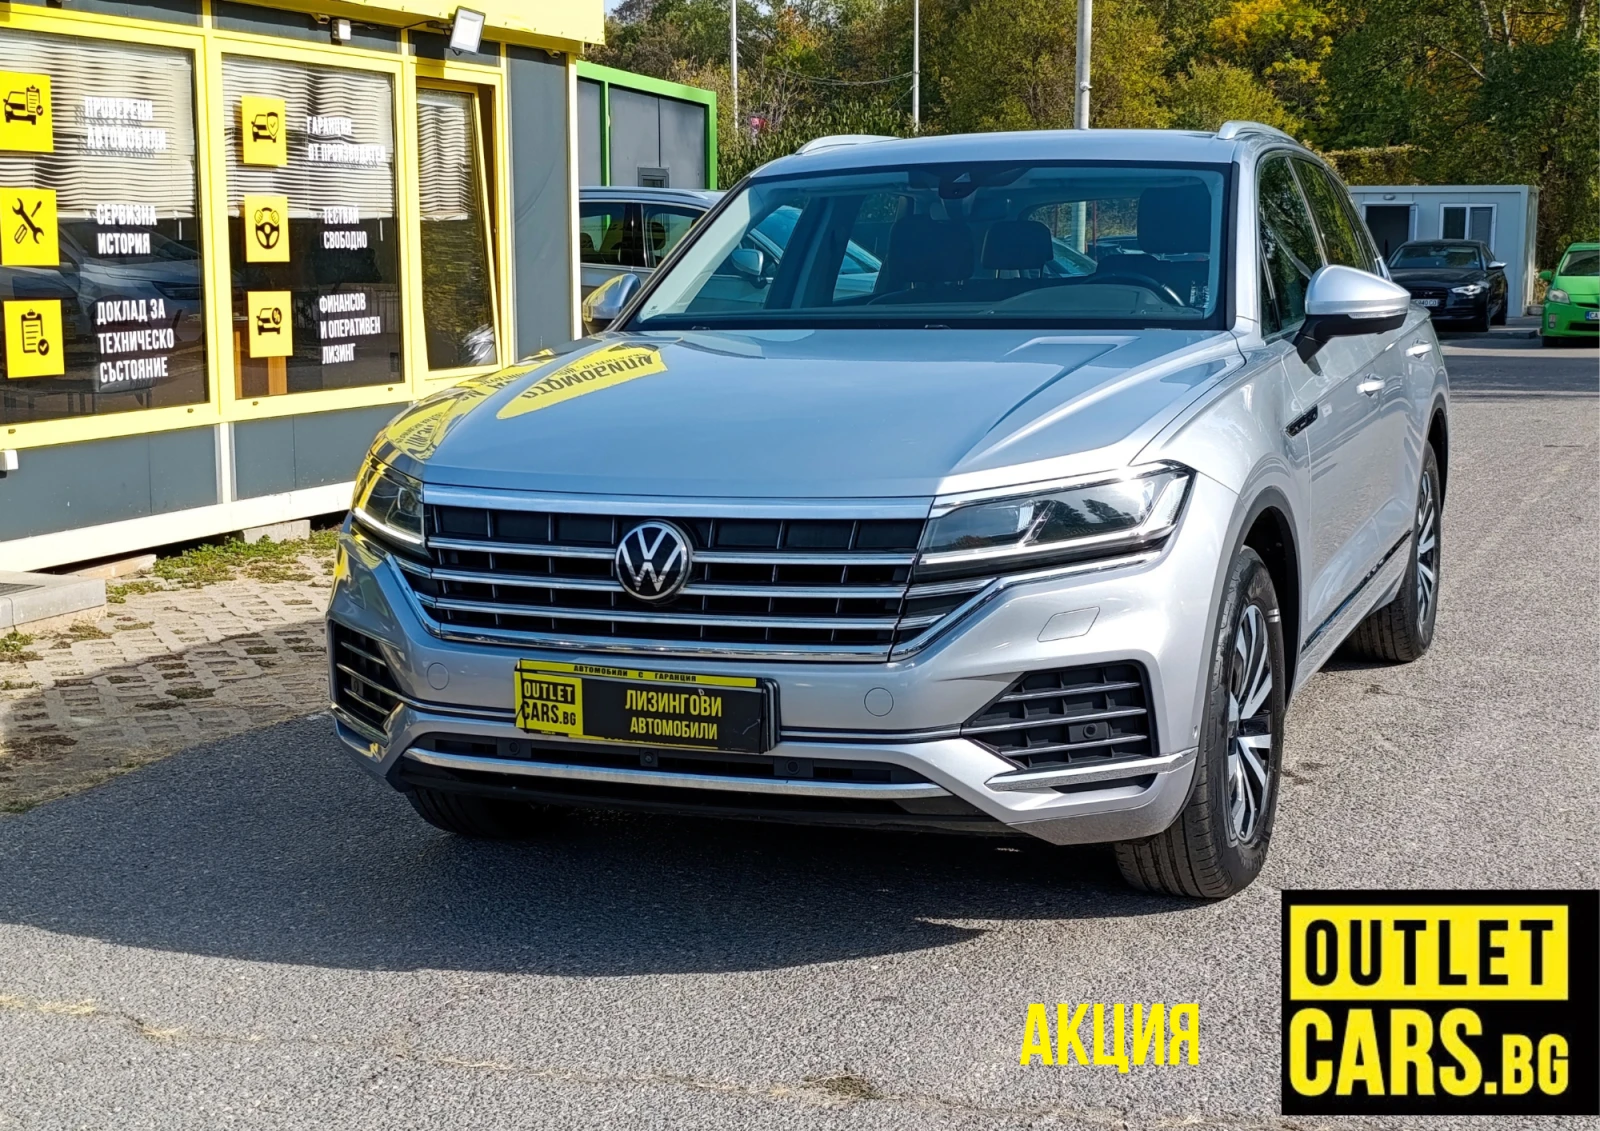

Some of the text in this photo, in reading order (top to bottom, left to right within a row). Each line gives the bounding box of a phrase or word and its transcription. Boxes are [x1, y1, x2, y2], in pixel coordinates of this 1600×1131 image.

[87, 127, 166, 149] АВТОМОБИЛИ
[96, 204, 157, 226] СЕРВИЗНА
[322, 205, 359, 224] ТЕСТВАЙ
[97, 233, 150, 254] ИСТОРИЯ
[323, 231, 368, 250] СВОБОДНО
[96, 298, 166, 325] ДОКЛАД ЗА
[319, 293, 366, 313] ФИНАНСОВ
[320, 316, 381, 339] И ОПЕРАТИВЕН
[98, 328, 174, 354] ТЕХНИЧЕСКО
[322, 343, 355, 364] ЛИЗИНГ
[100, 357, 168, 383] СЪСТОЯНИЕ
[573, 665, 628, 677] АВТОМОБИЛИ
[655, 673, 697, 682] ГАРАНЦИЯ
[523, 681, 573, 702] OUTLET
[521, 701, 576, 726] CARS.BG
[625, 689, 722, 717] ЛИЗИНГОВИ
[630, 717, 718, 740] АВТОМОБИЛИ
